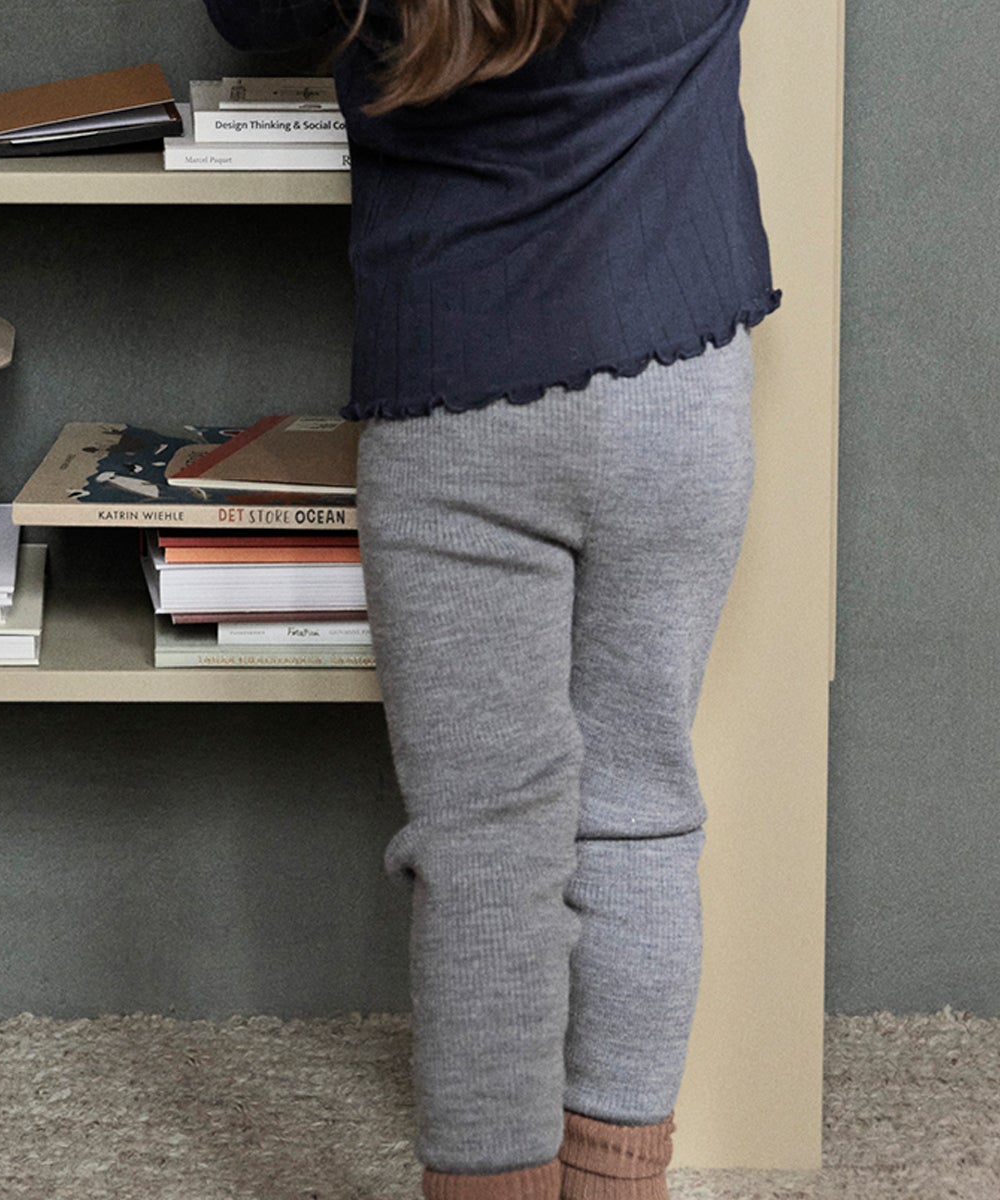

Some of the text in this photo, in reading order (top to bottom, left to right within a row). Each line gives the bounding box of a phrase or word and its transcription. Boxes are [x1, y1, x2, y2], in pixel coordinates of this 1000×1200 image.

[215, 120, 248, 132] Design
[250, 120, 292, 132] Thinking
[293, 120, 301, 130] &
[303, 120, 332, 130] Social
[98, 511, 184, 521] KATRIN WIEHLE
[218, 508, 346, 525] DET STORE OCEAN
